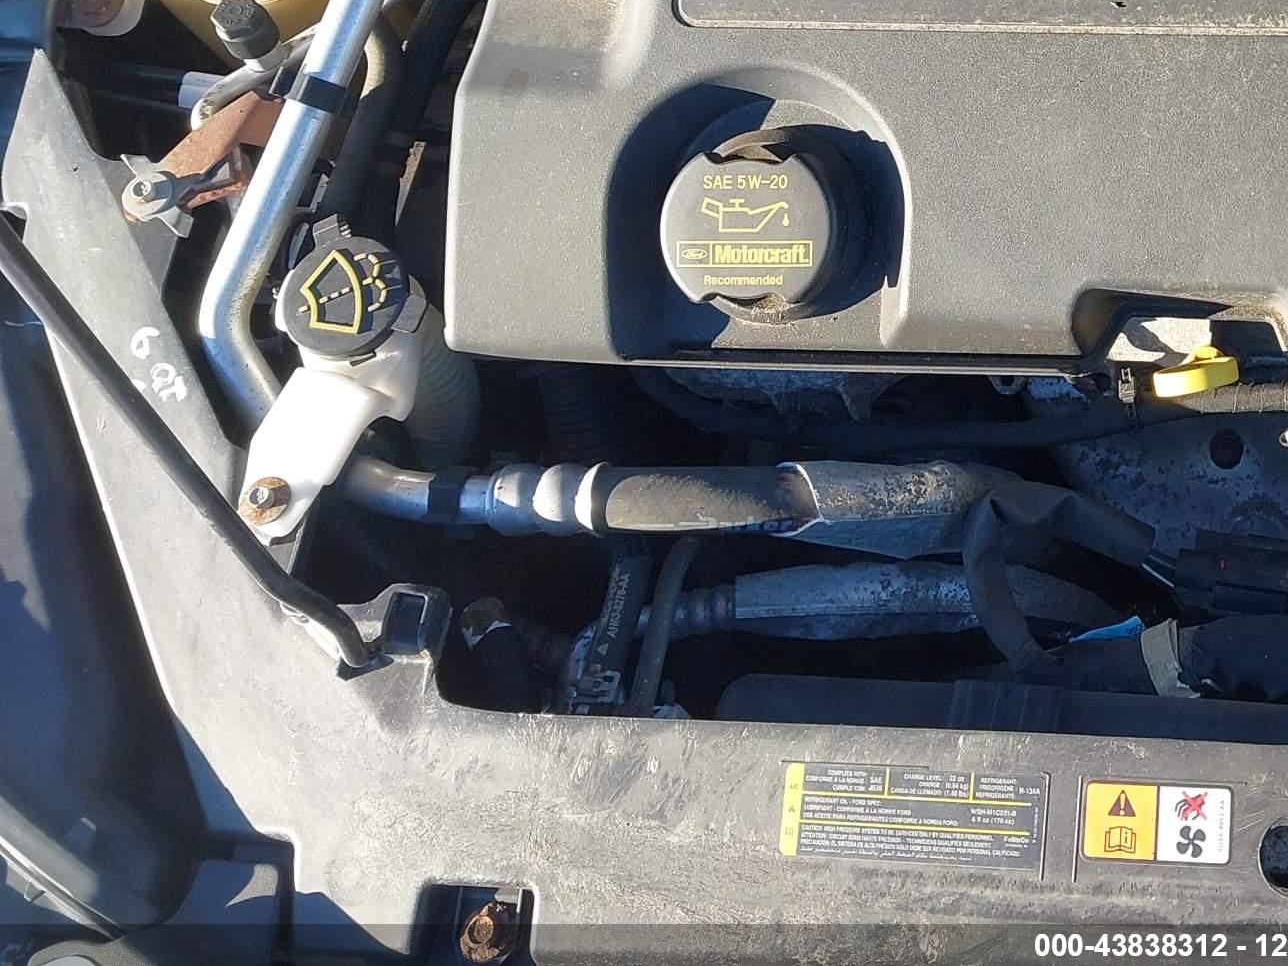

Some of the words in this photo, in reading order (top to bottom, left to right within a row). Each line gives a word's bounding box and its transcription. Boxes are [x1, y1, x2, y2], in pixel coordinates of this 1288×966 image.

[703, 175, 732, 189] SAE
[738, 175, 788, 189] 5W-20
[714, 243, 809, 264] Motorcraft
[703, 274, 783, 286] Recommended
[869, 776, 883, 784] SAE
